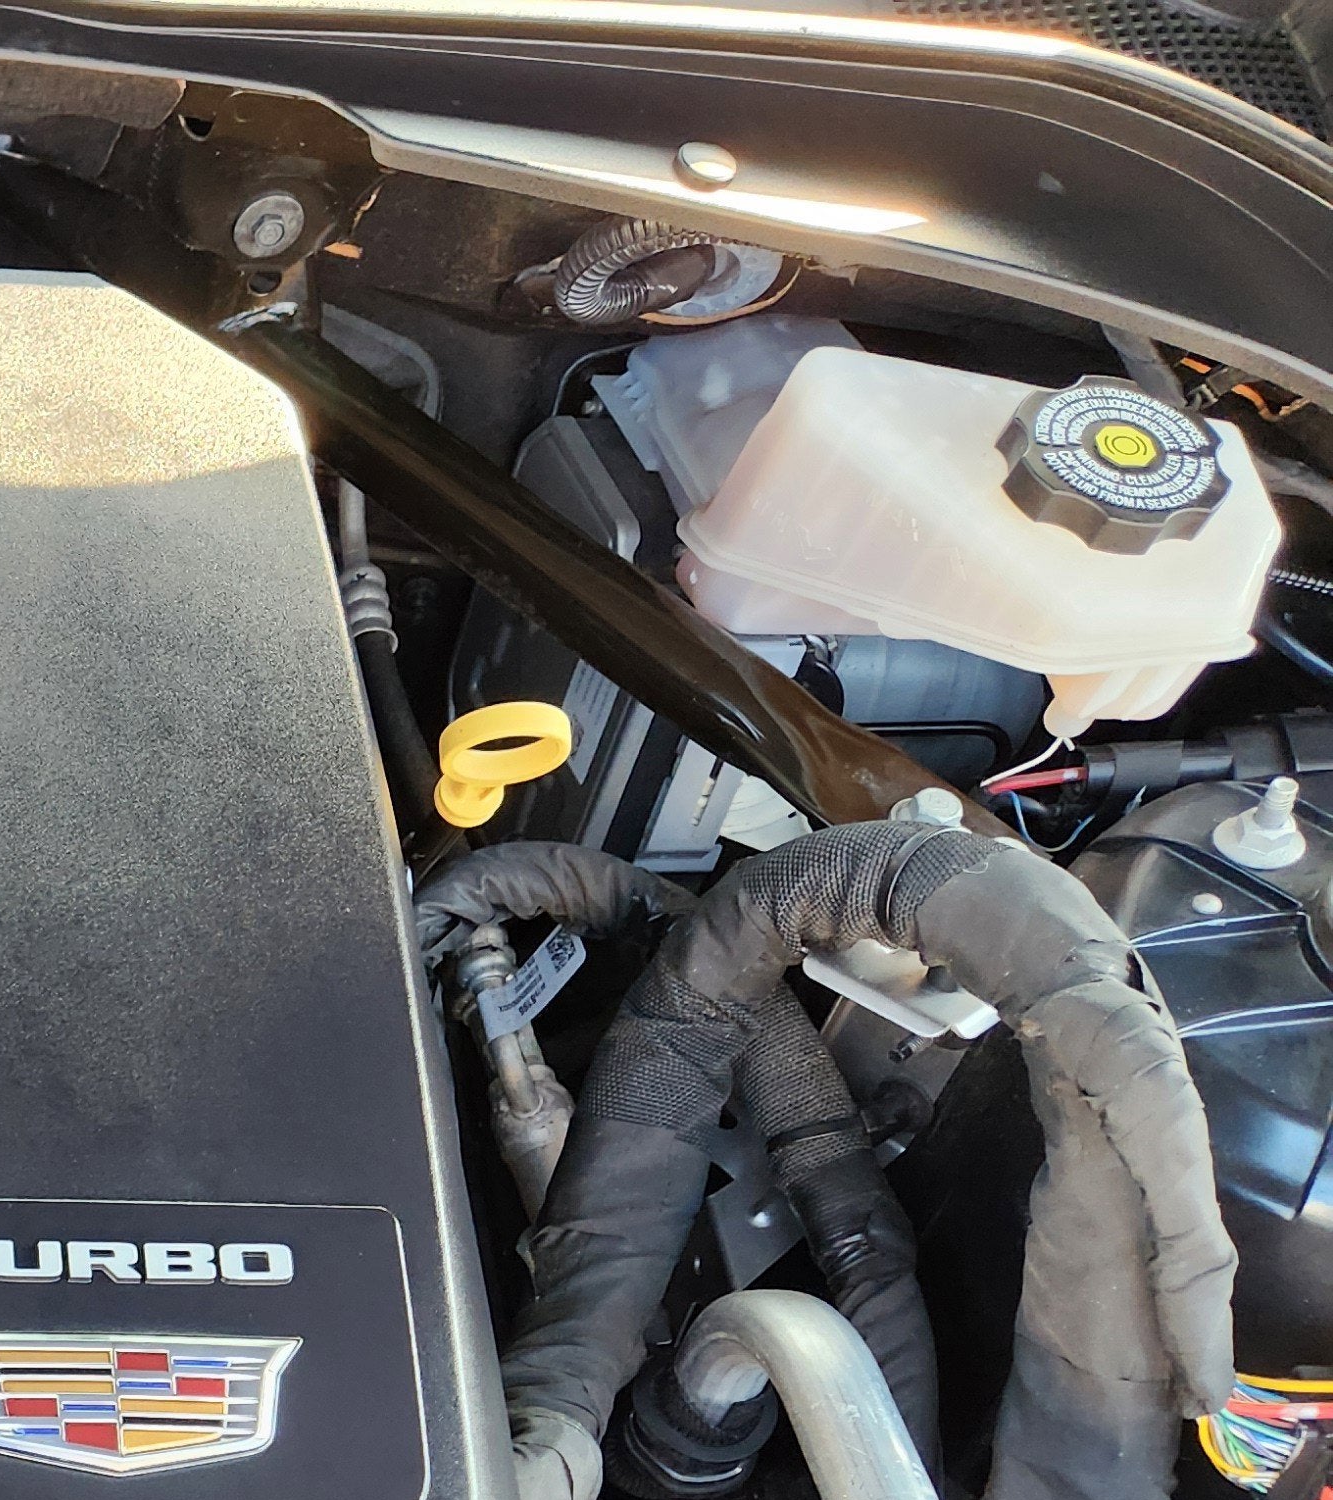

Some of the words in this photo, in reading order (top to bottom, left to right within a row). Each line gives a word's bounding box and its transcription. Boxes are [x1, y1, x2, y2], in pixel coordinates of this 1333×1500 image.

[1089, 387, 1104, 397] LE
[1058, 450, 1081, 468] CAP
[1073, 465, 1118, 493] BEFORE
[1125, 472, 1165, 486] CLEAN
[1064, 473, 1099, 496] FLUID
[1098, 490, 1135, 508] FROM
[1145, 494, 1190, 511] SEALED
